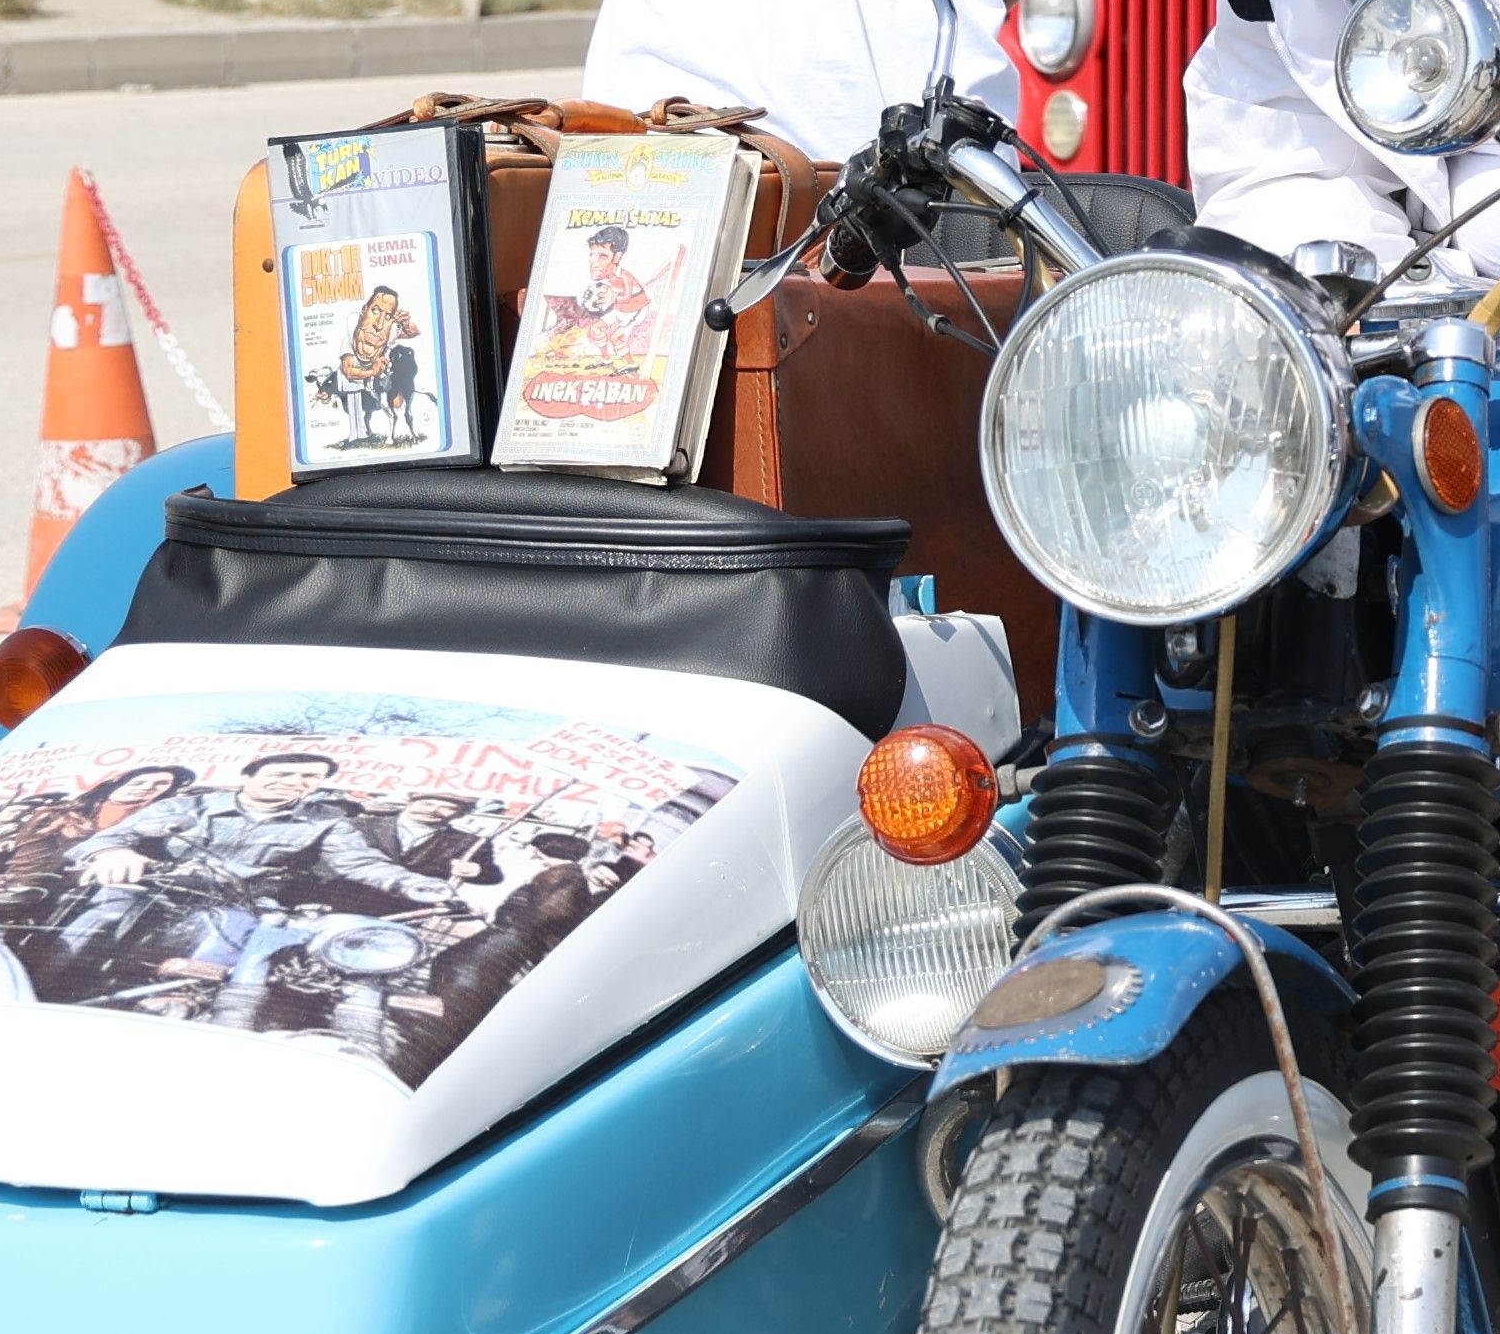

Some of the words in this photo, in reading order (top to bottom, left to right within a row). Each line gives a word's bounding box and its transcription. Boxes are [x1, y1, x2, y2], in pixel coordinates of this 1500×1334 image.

[367, 238, 417, 254] KEMAL
[301, 245, 363, 277] DOKTOR
[369, 253, 416, 268] SUNAL
[580, 380, 647, 407] ŞABAN
[526, 740, 669, 802] DOKTOR
